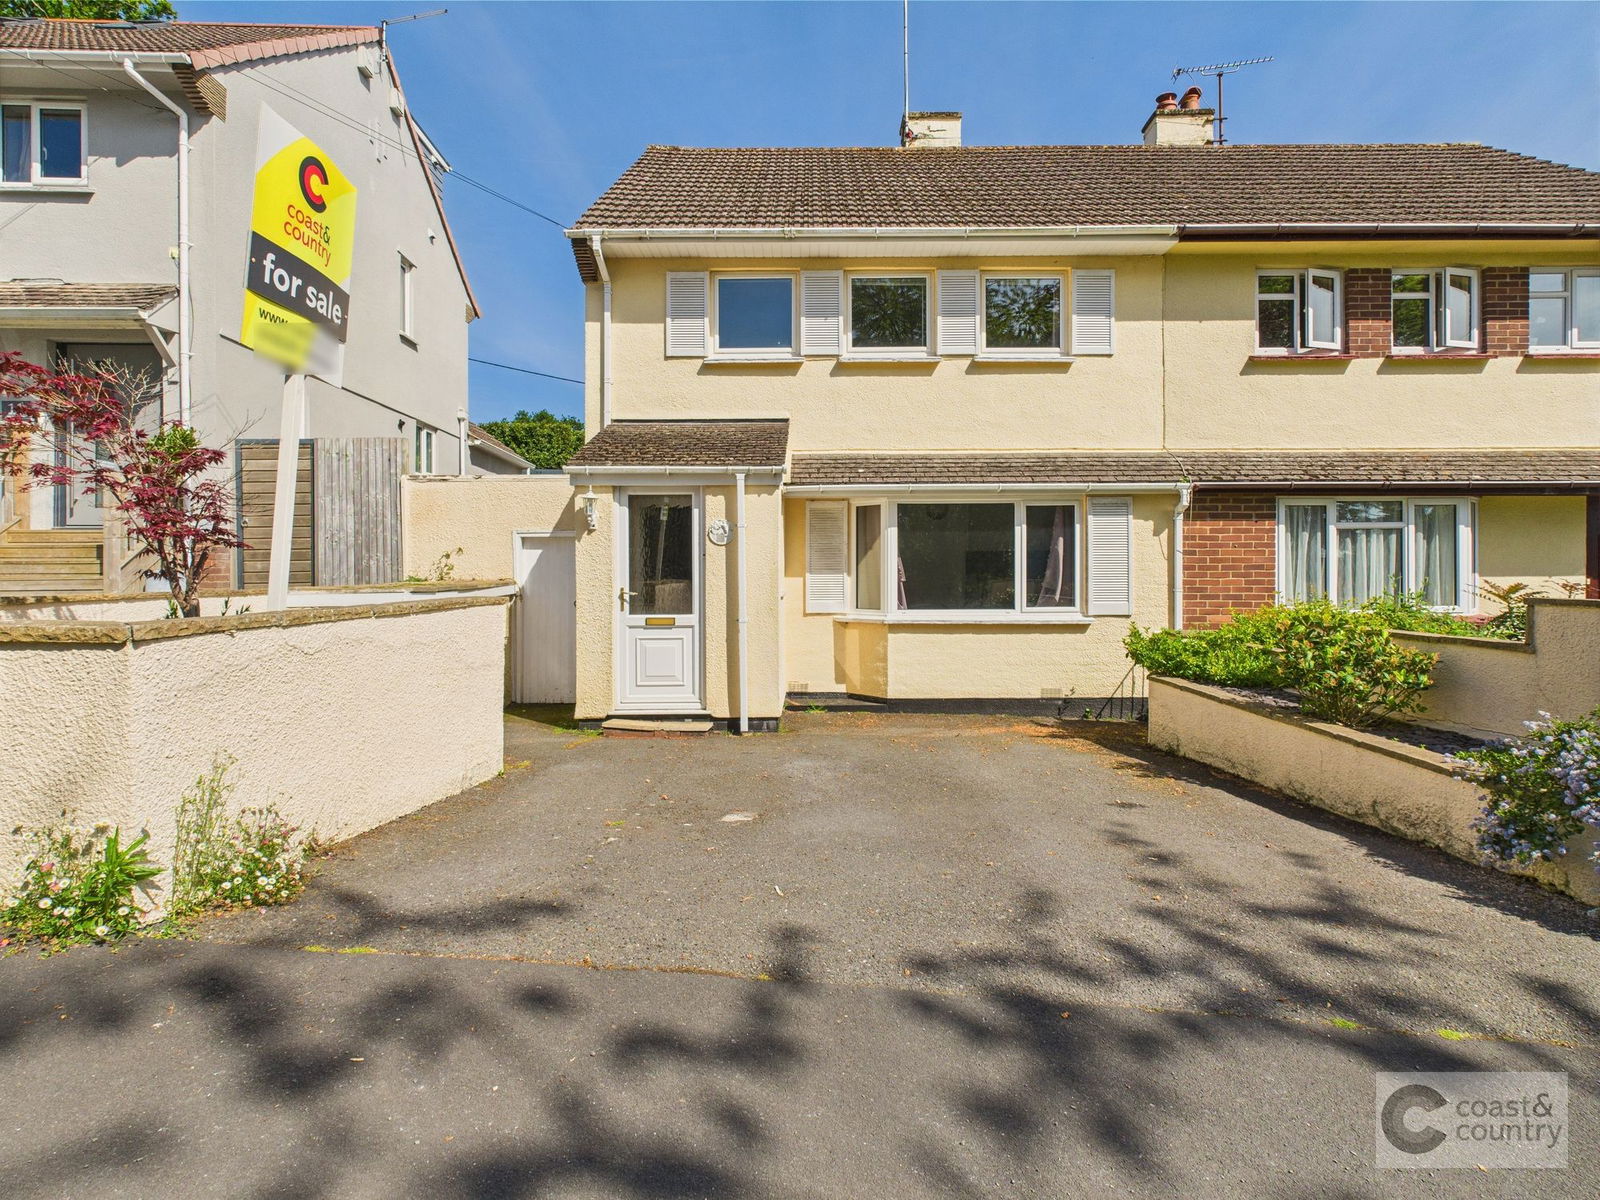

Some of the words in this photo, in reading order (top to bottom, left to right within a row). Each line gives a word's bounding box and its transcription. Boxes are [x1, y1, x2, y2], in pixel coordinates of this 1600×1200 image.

[284, 220, 331, 267] country
[287, 204, 330, 245] coast&
[263, 252, 302, 299] for
[305, 284, 342, 325] sale
